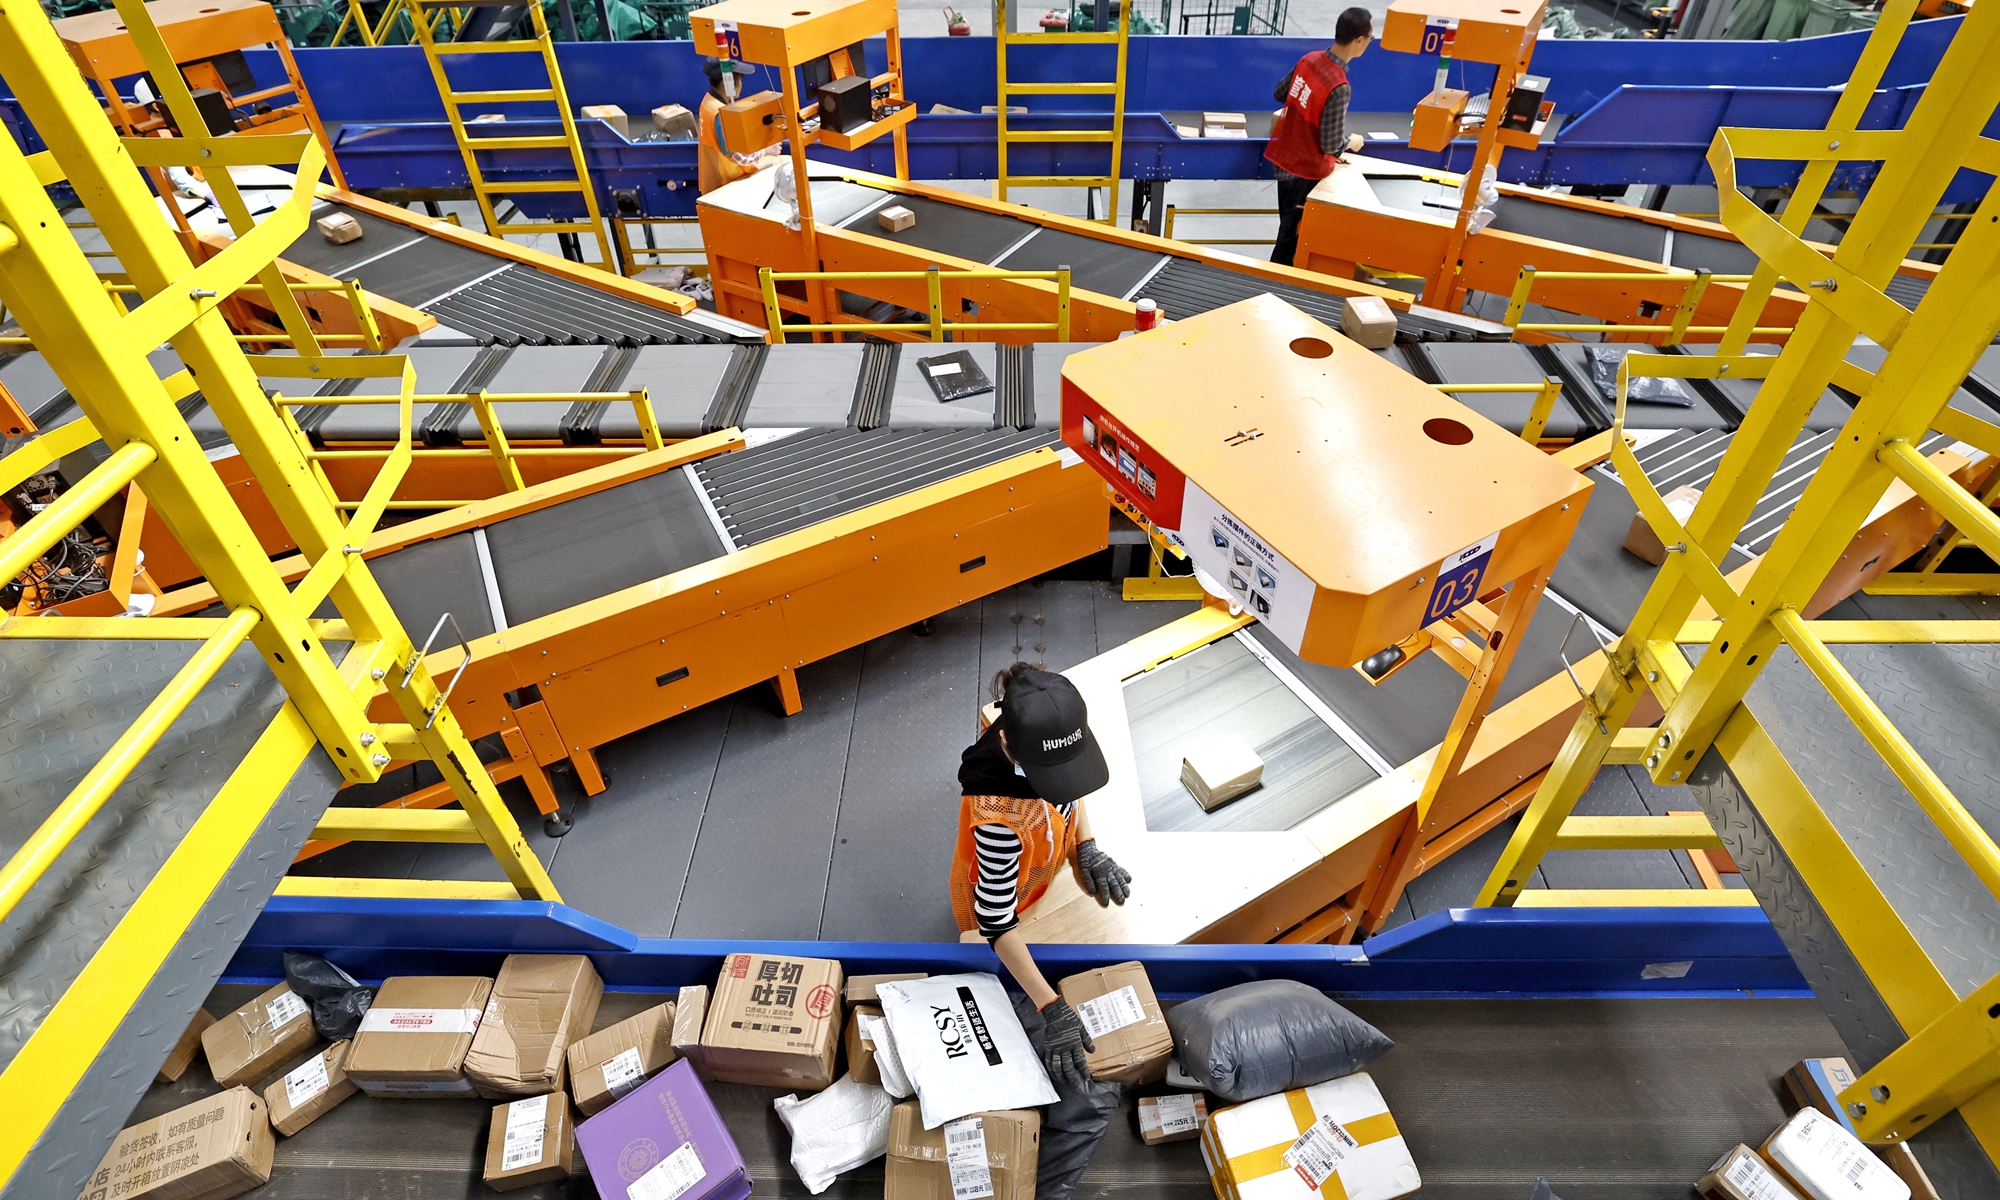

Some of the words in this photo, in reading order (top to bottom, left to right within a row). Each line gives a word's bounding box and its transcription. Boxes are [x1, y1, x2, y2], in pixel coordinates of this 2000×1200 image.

[1425, 32, 1445, 52] 0
[1431, 568, 1479, 618] 03
[1042, 728, 1083, 752] HUMOUR
[755, 960, 804, 985] 厚切
[750, 983, 798, 1009] 吐司
[930, 1005, 969, 1060] RCSY
[110, 1151, 200, 1199] 及时开箱放置阴凉处
